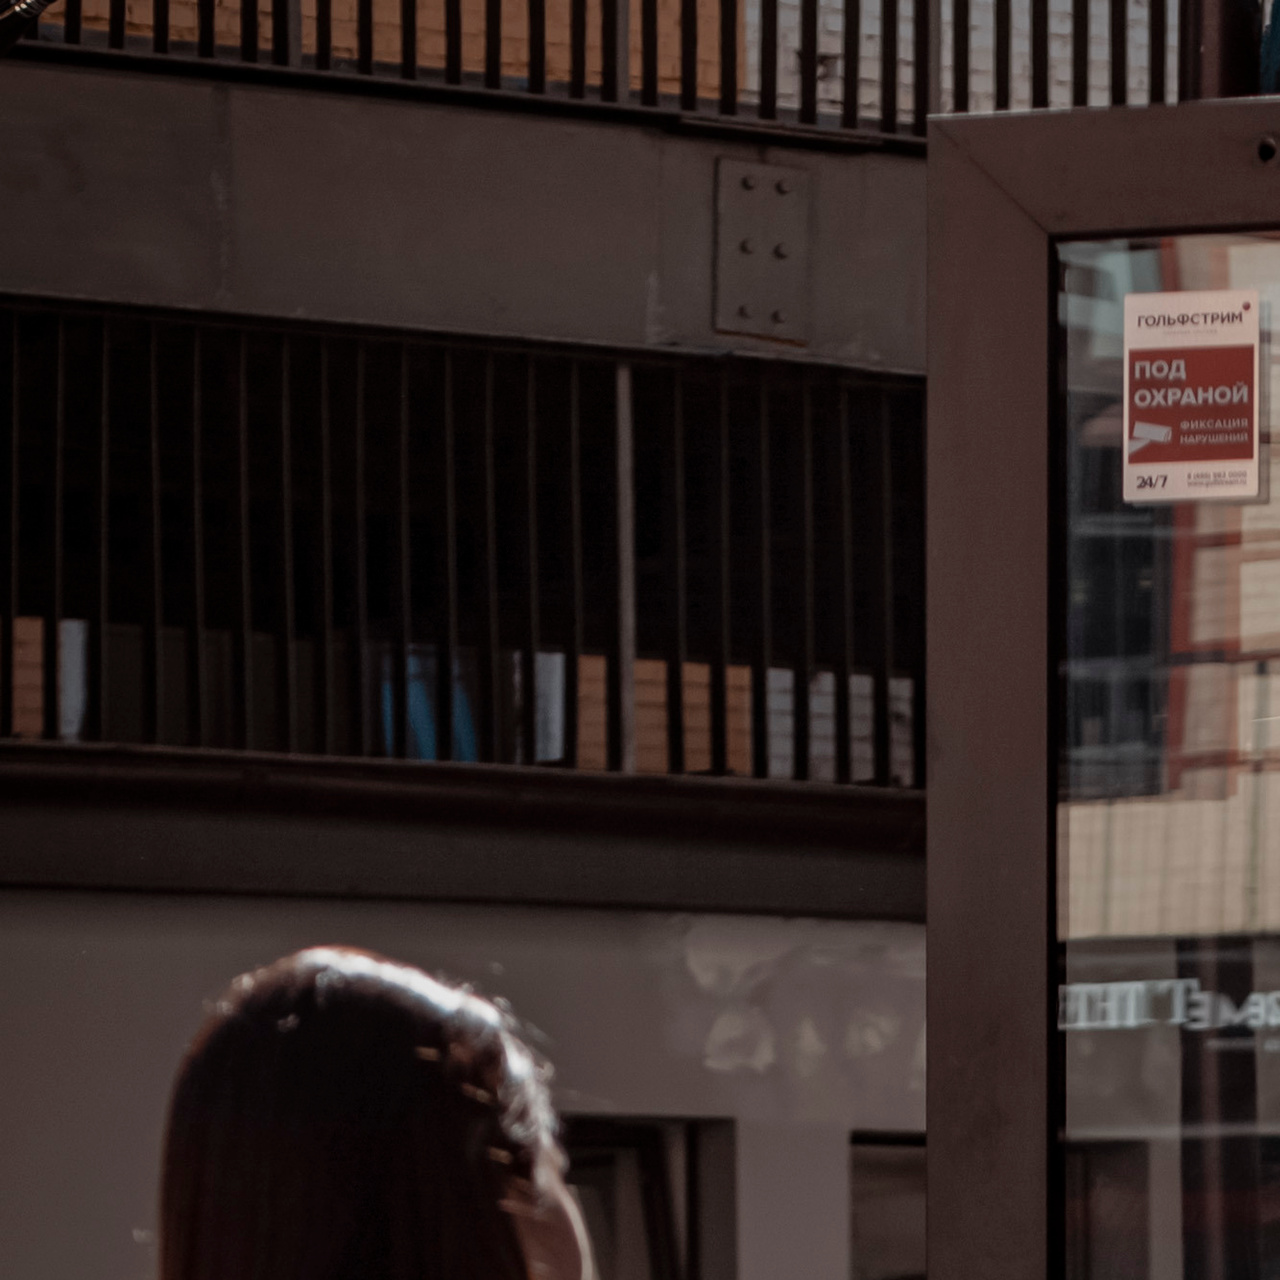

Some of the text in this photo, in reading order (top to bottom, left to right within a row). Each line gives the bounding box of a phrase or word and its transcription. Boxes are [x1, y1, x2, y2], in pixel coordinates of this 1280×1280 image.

[1137, 311, 1243, 327] ГОЛЬФСТРИМ
[1134, 359, 1186, 380] ПОД
[1134, 382, 1248, 407] ОХРАНОЙ
[1180, 418, 1248, 431] ФИКСАЦИЯ
[1180, 431, 1248, 445] НАРУШЕНИЙ
[1136, 475, 1168, 489] 24/7
